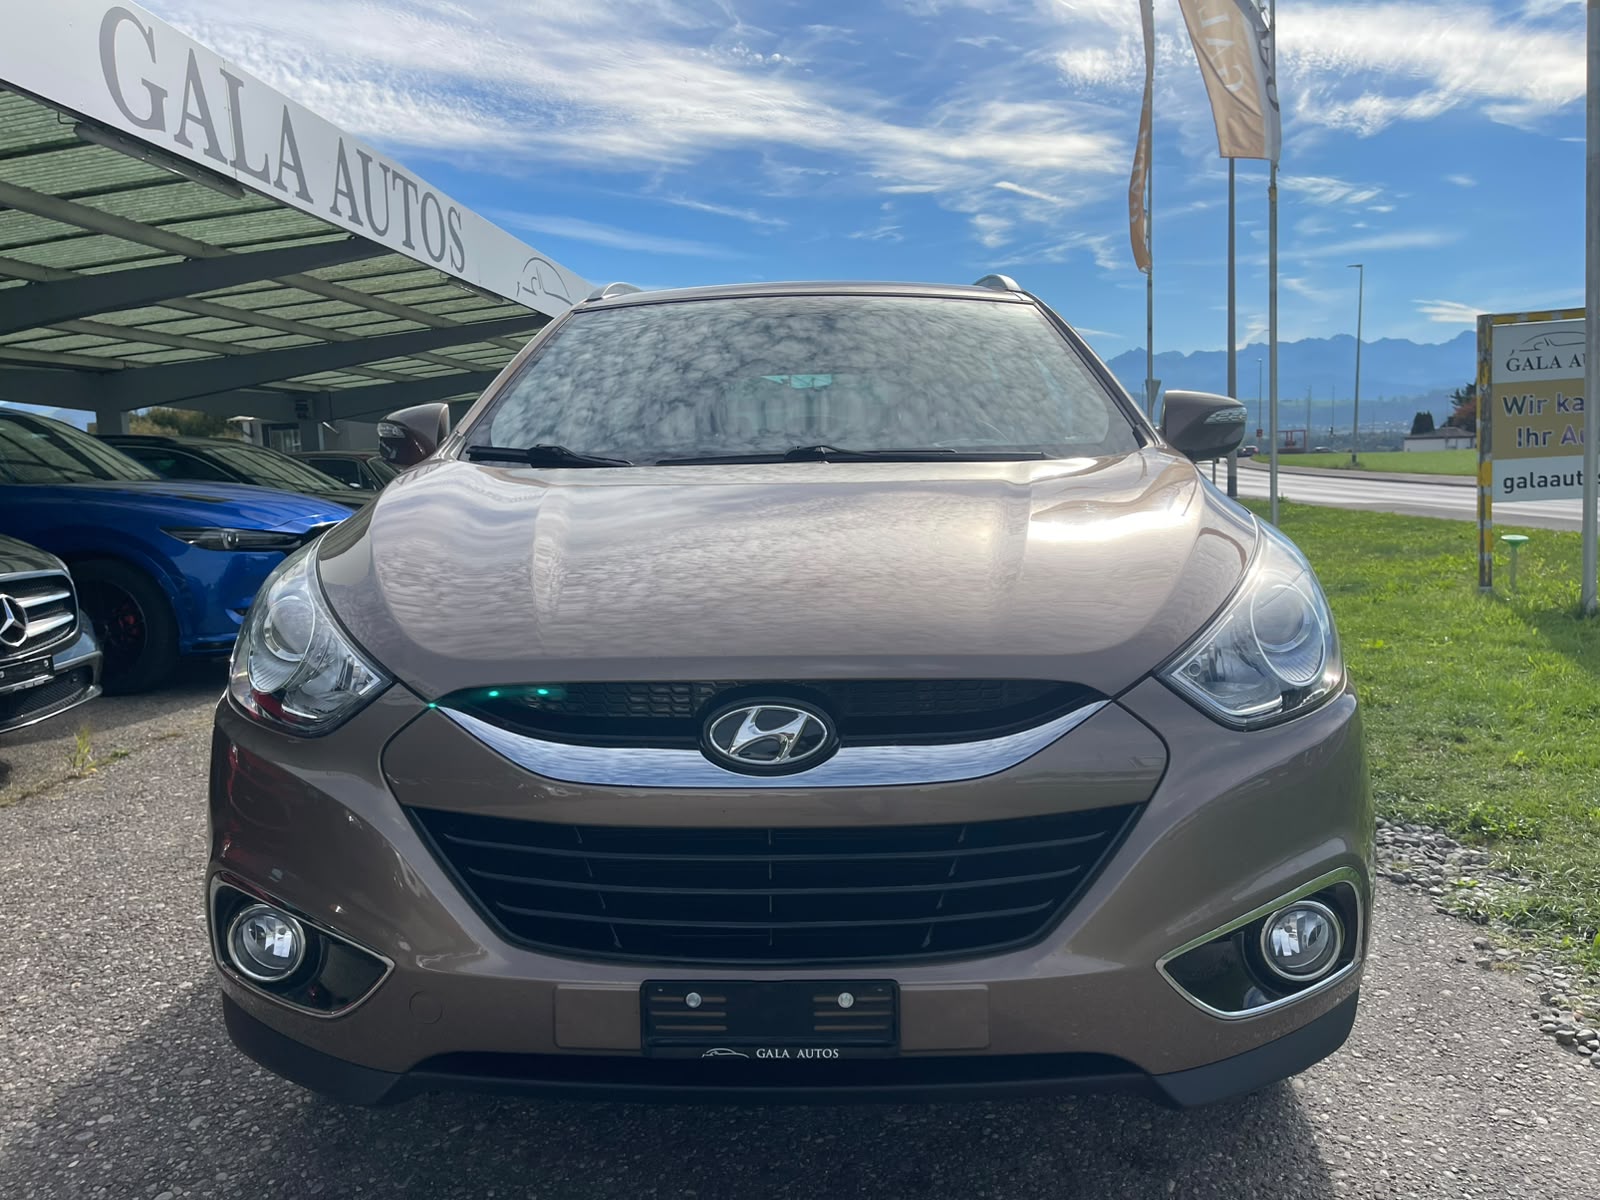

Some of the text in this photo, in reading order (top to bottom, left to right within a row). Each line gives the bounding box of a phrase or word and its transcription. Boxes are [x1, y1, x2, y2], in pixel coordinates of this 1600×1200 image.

[98, 6, 466, 274] GALA AUTOS
[1506, 353, 1585, 372] GALA A
[1503, 394, 1547, 414] Wir
[1516, 426, 1552, 448] Ihr
[1503, 470, 1600, 494] galaaut
[756, 1048, 839, 1059] GALA AUTOS
